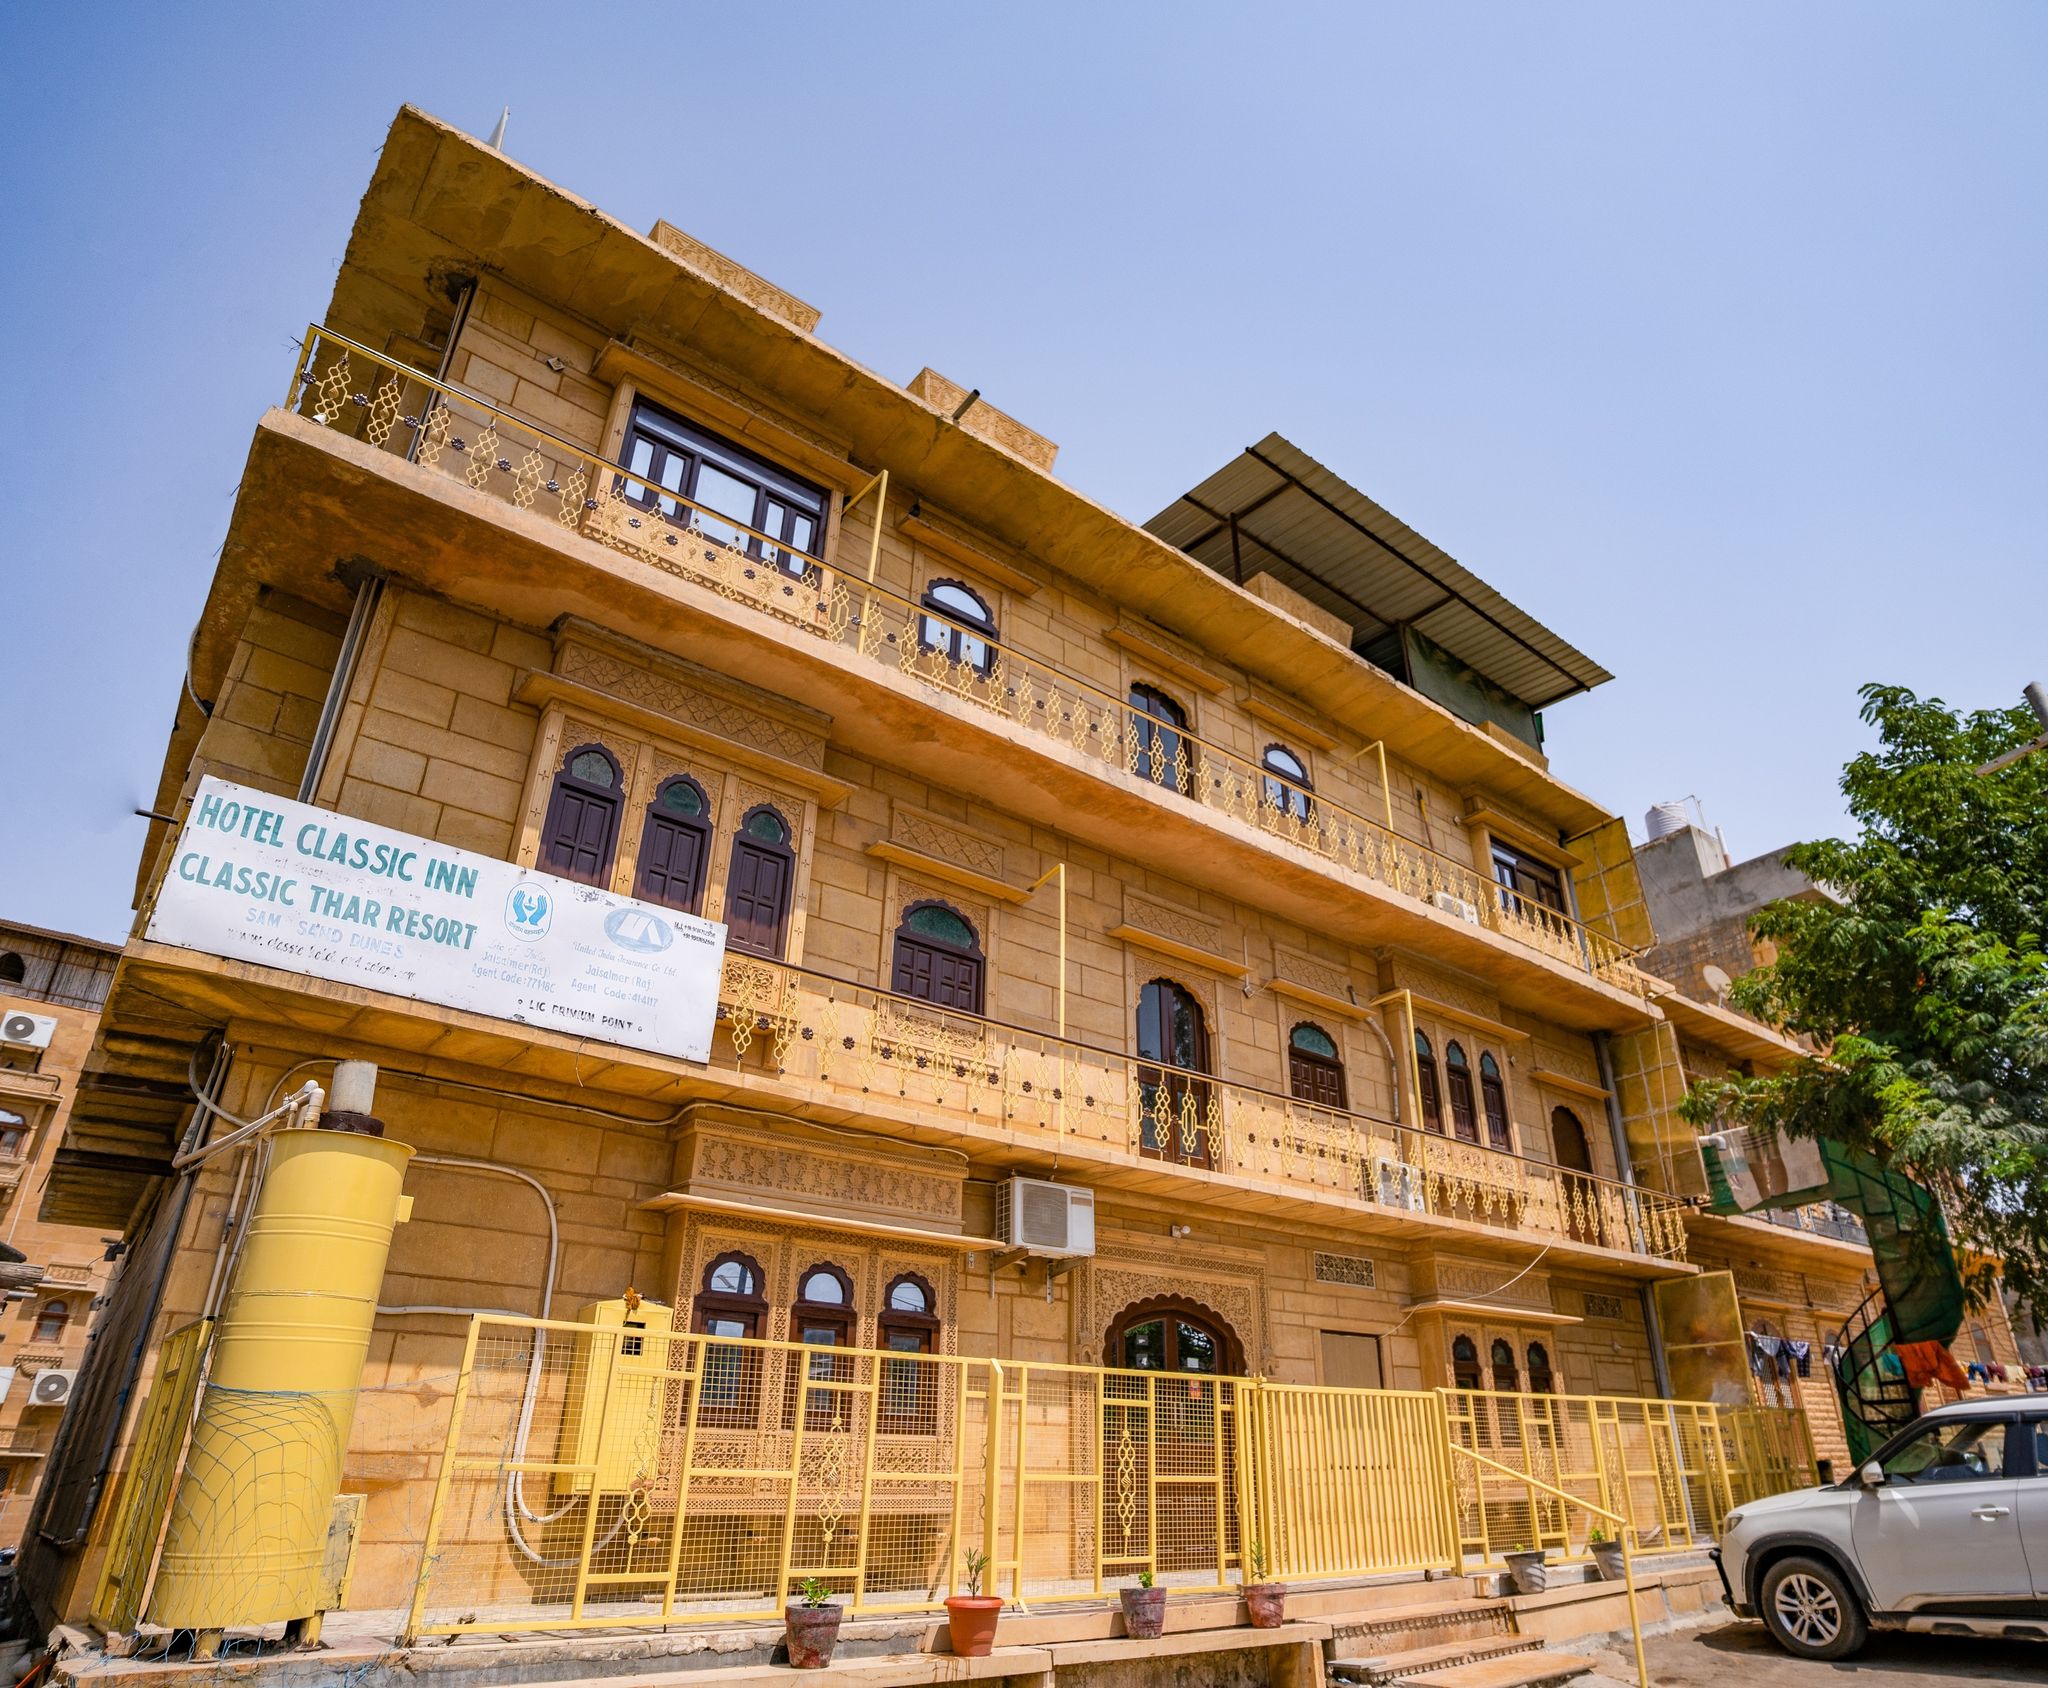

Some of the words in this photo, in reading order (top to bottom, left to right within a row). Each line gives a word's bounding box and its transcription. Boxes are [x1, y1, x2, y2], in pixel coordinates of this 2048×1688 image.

[197, 794, 285, 848] HOTEL
[296, 823, 417, 882] CLASSIC
[424, 858, 479, 898] INN
[178, 853, 297, 906] CLASSIC
[310, 885, 381, 927] THAR
[387, 905, 478, 950] RESORT
[246, 908, 282, 928] SAM
[350, 933, 406, 959] DUNES
[472, 963, 497, 979] Agent
[571, 978, 597, 993] Agent
[585, 964, 630, 984] Jaisalmer
[528, 999, 547, 1013] LIC
[601, 1015, 634, 1032] POINT
